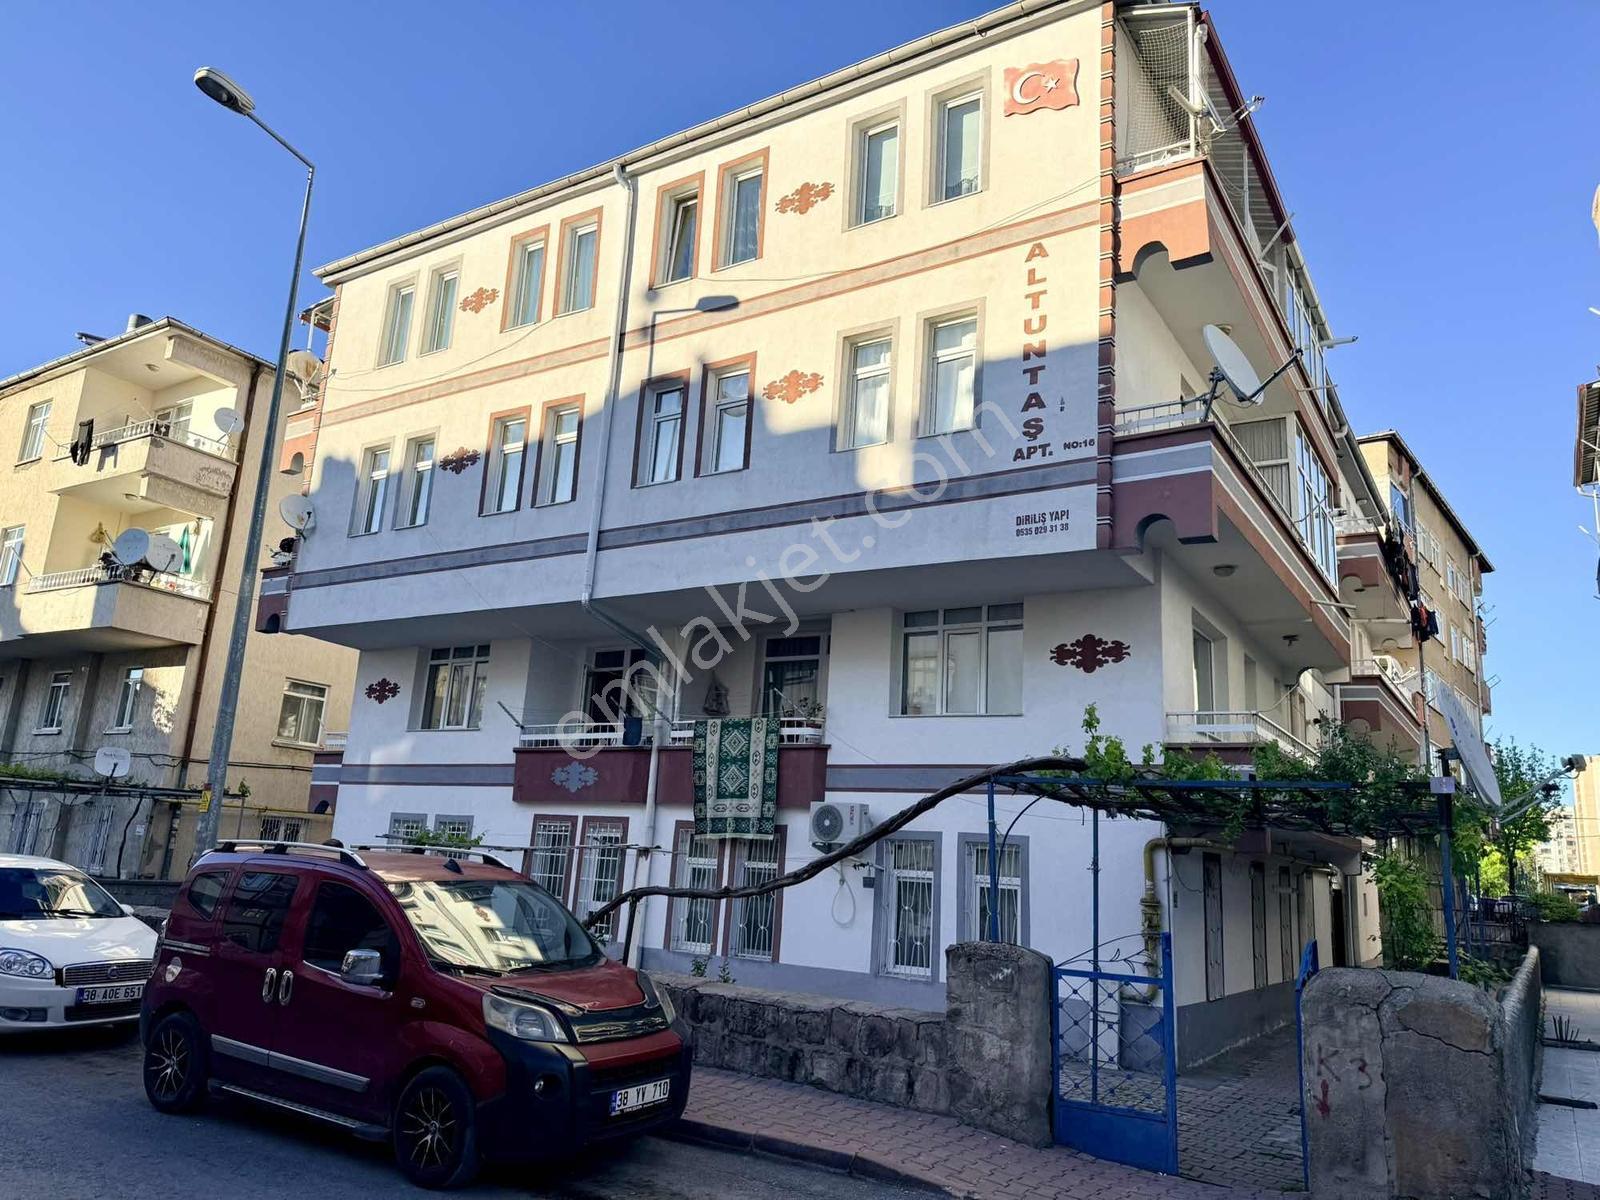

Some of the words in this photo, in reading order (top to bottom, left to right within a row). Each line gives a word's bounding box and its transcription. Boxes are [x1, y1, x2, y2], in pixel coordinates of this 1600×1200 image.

[1021, 242, 1049, 442] ALTUNTAŞ
[1012, 443, 1053, 462] APT.
[1049, 509, 1070, 522] YAPI
[84, 989, 97, 1001] 38
[124, 986, 141, 998] 651
[617, 1091, 629, 1108] 38
[652, 1081, 668, 1099] 710
